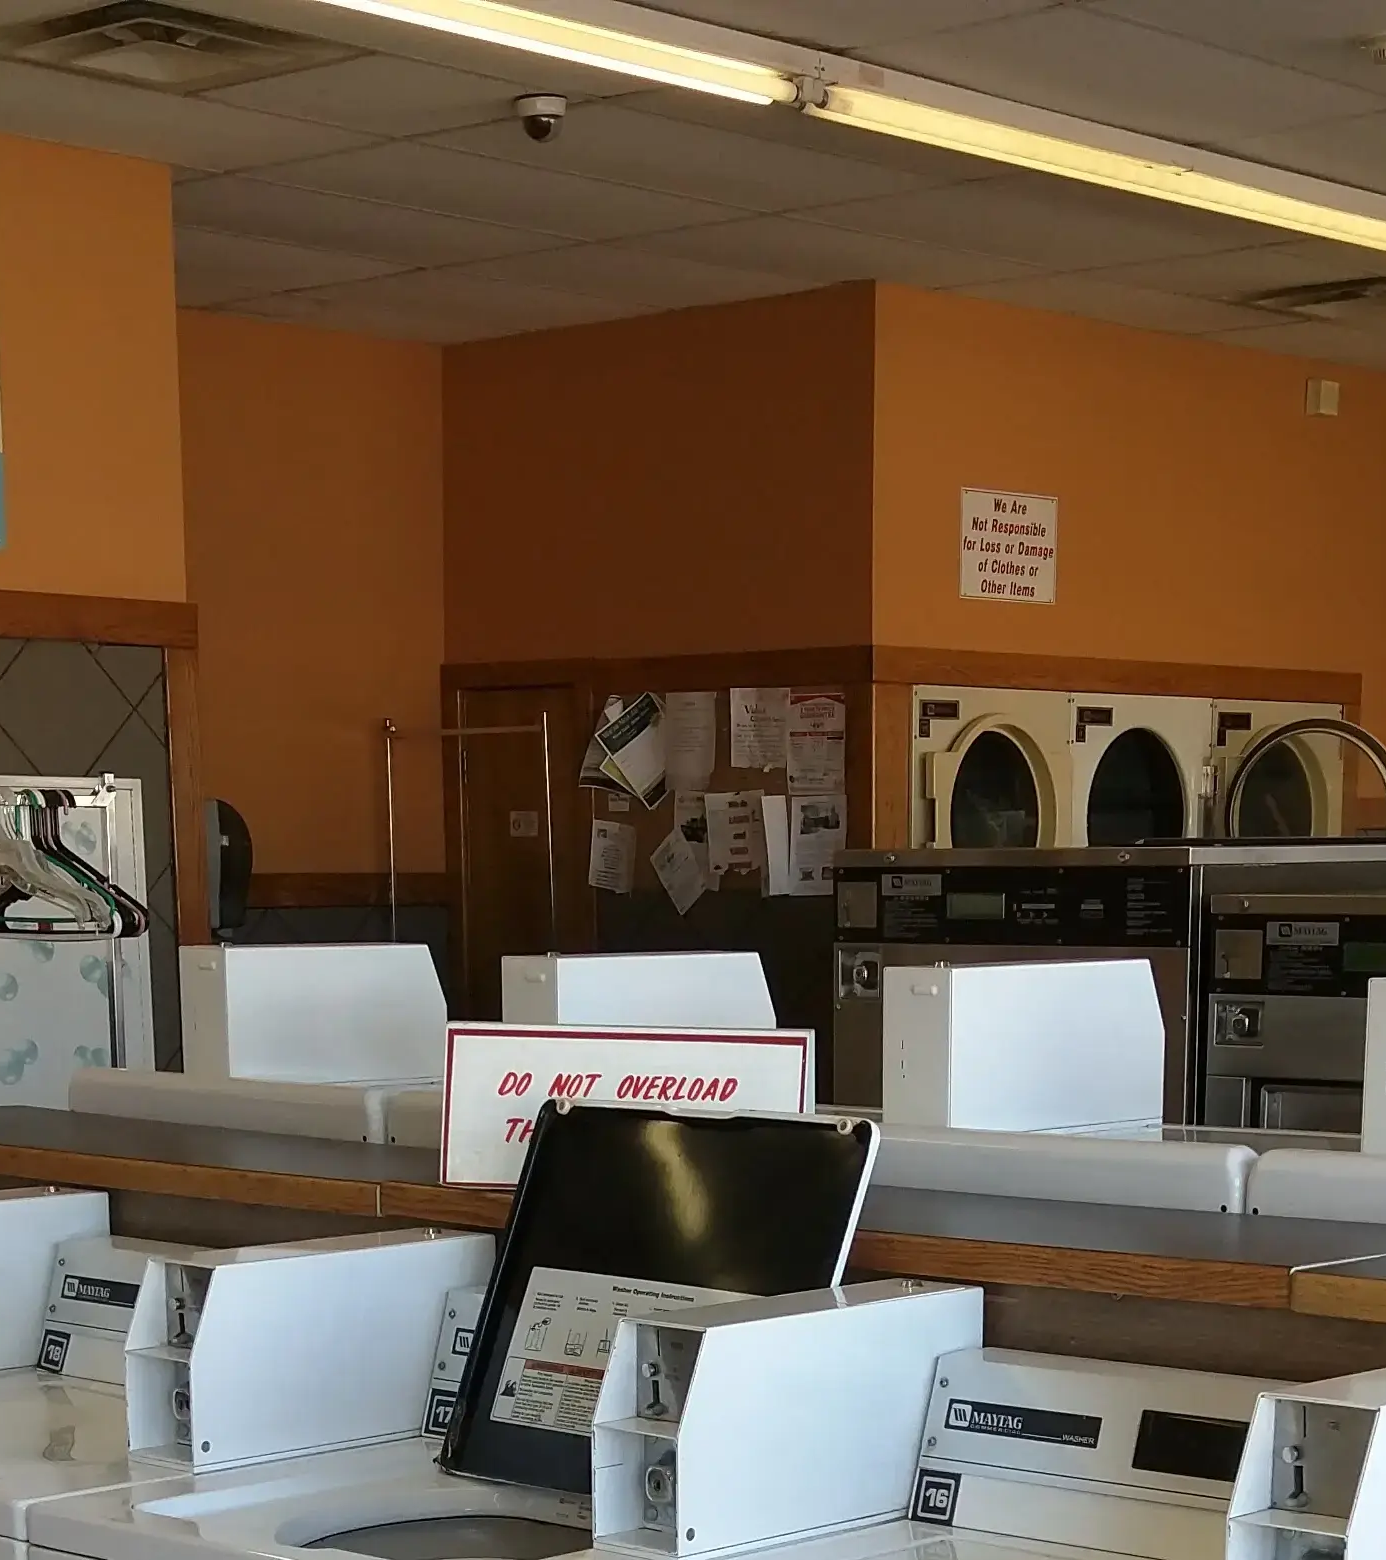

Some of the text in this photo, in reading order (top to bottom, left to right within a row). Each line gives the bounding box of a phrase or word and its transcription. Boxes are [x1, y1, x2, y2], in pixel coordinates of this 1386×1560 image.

[994, 498, 1027, 515] We Are
[972, 517, 1046, 537] Not Responsible
[963, 536, 1054, 560] for Loss or Damage
[978, 558, 1039, 577] of Clothes or
[981, 579, 1035, 597] Other Items
[497, 1071, 739, 1101] DO NOT OVERLOAD
[78, 1284, 111, 1299] MAYTAG
[47, 1344, 62, 1361] 18
[436, 1406, 454, 1423] 17
[971, 1411, 1024, 1430] MAYTAG
[1062, 1434, 1095, 1445] WASHER
[925, 1488, 949, 1508] 16
